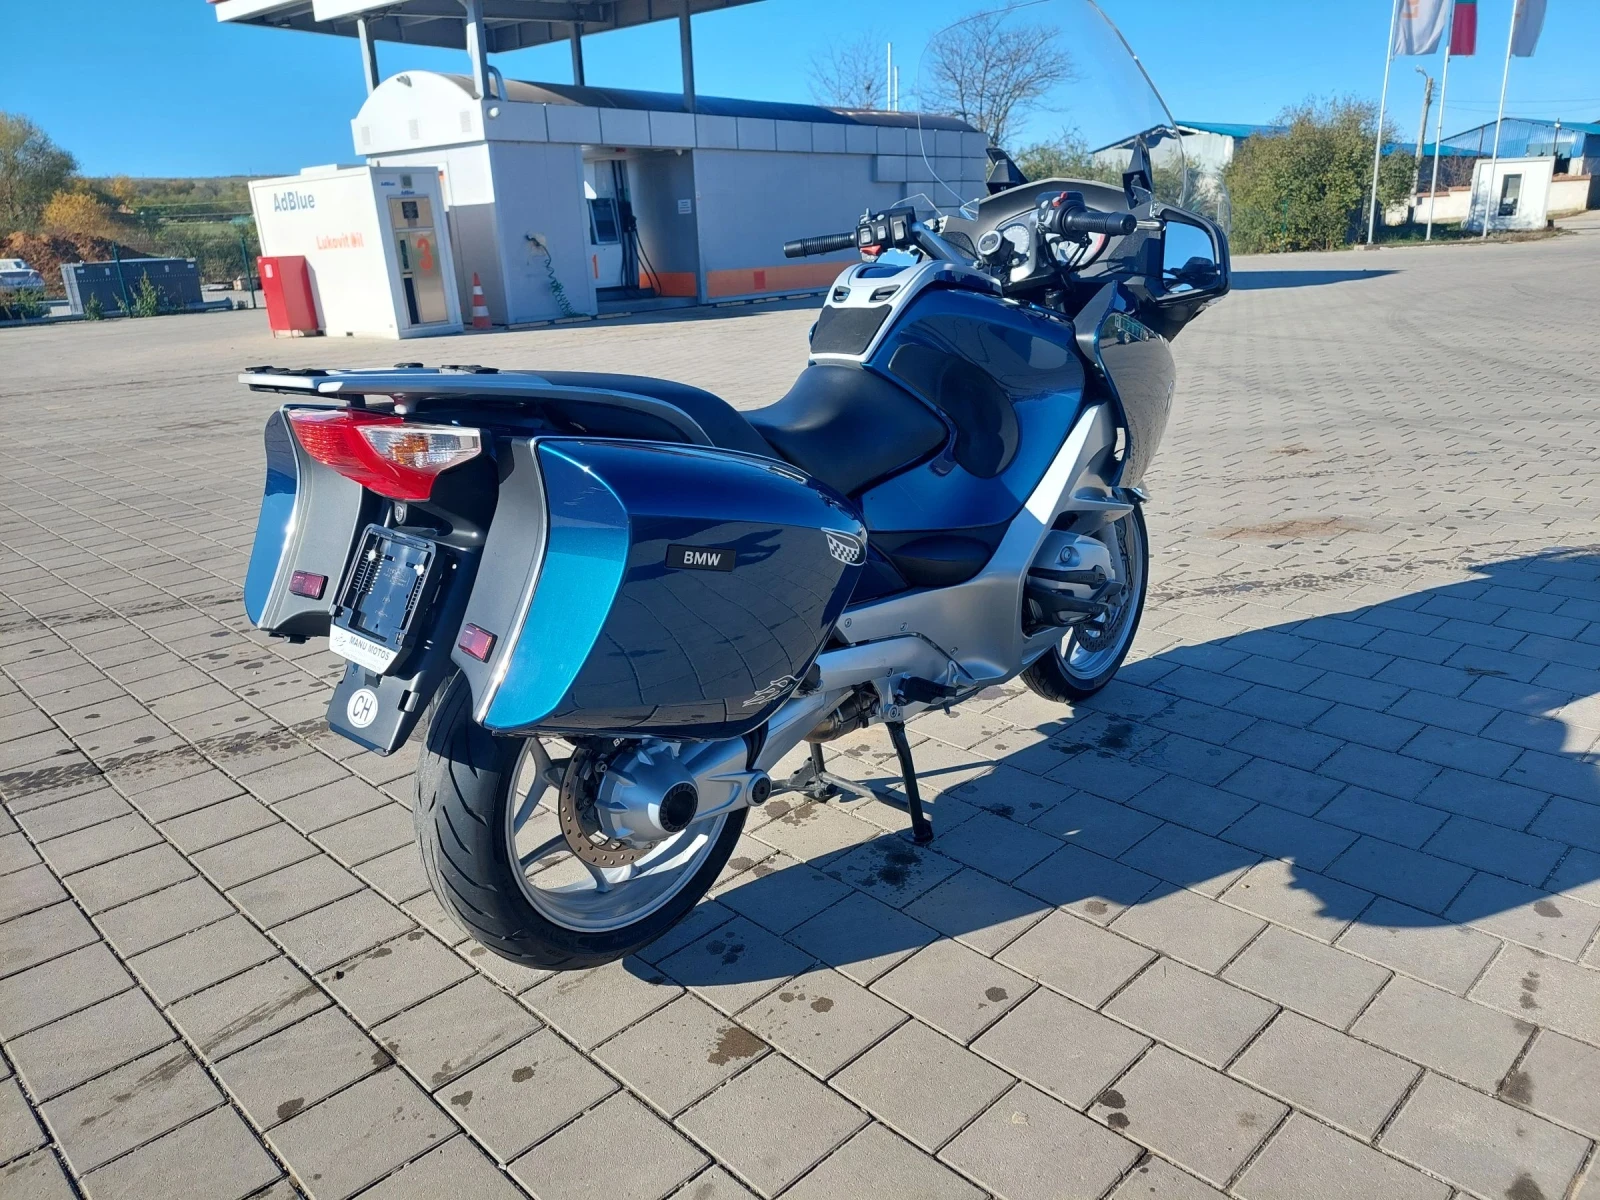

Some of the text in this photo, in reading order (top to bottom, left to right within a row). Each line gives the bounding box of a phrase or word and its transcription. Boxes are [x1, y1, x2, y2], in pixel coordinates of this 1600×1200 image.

[273, 190, 315, 212] AdBlue
[316, 232, 350, 250] Lukovit
[416, 236, 434, 270] 3
[683, 550, 721, 566] BMW
[349, 635, 368, 651] MANU
[367, 644, 391, 661] MOTOS
[353, 695, 373, 722] CH
